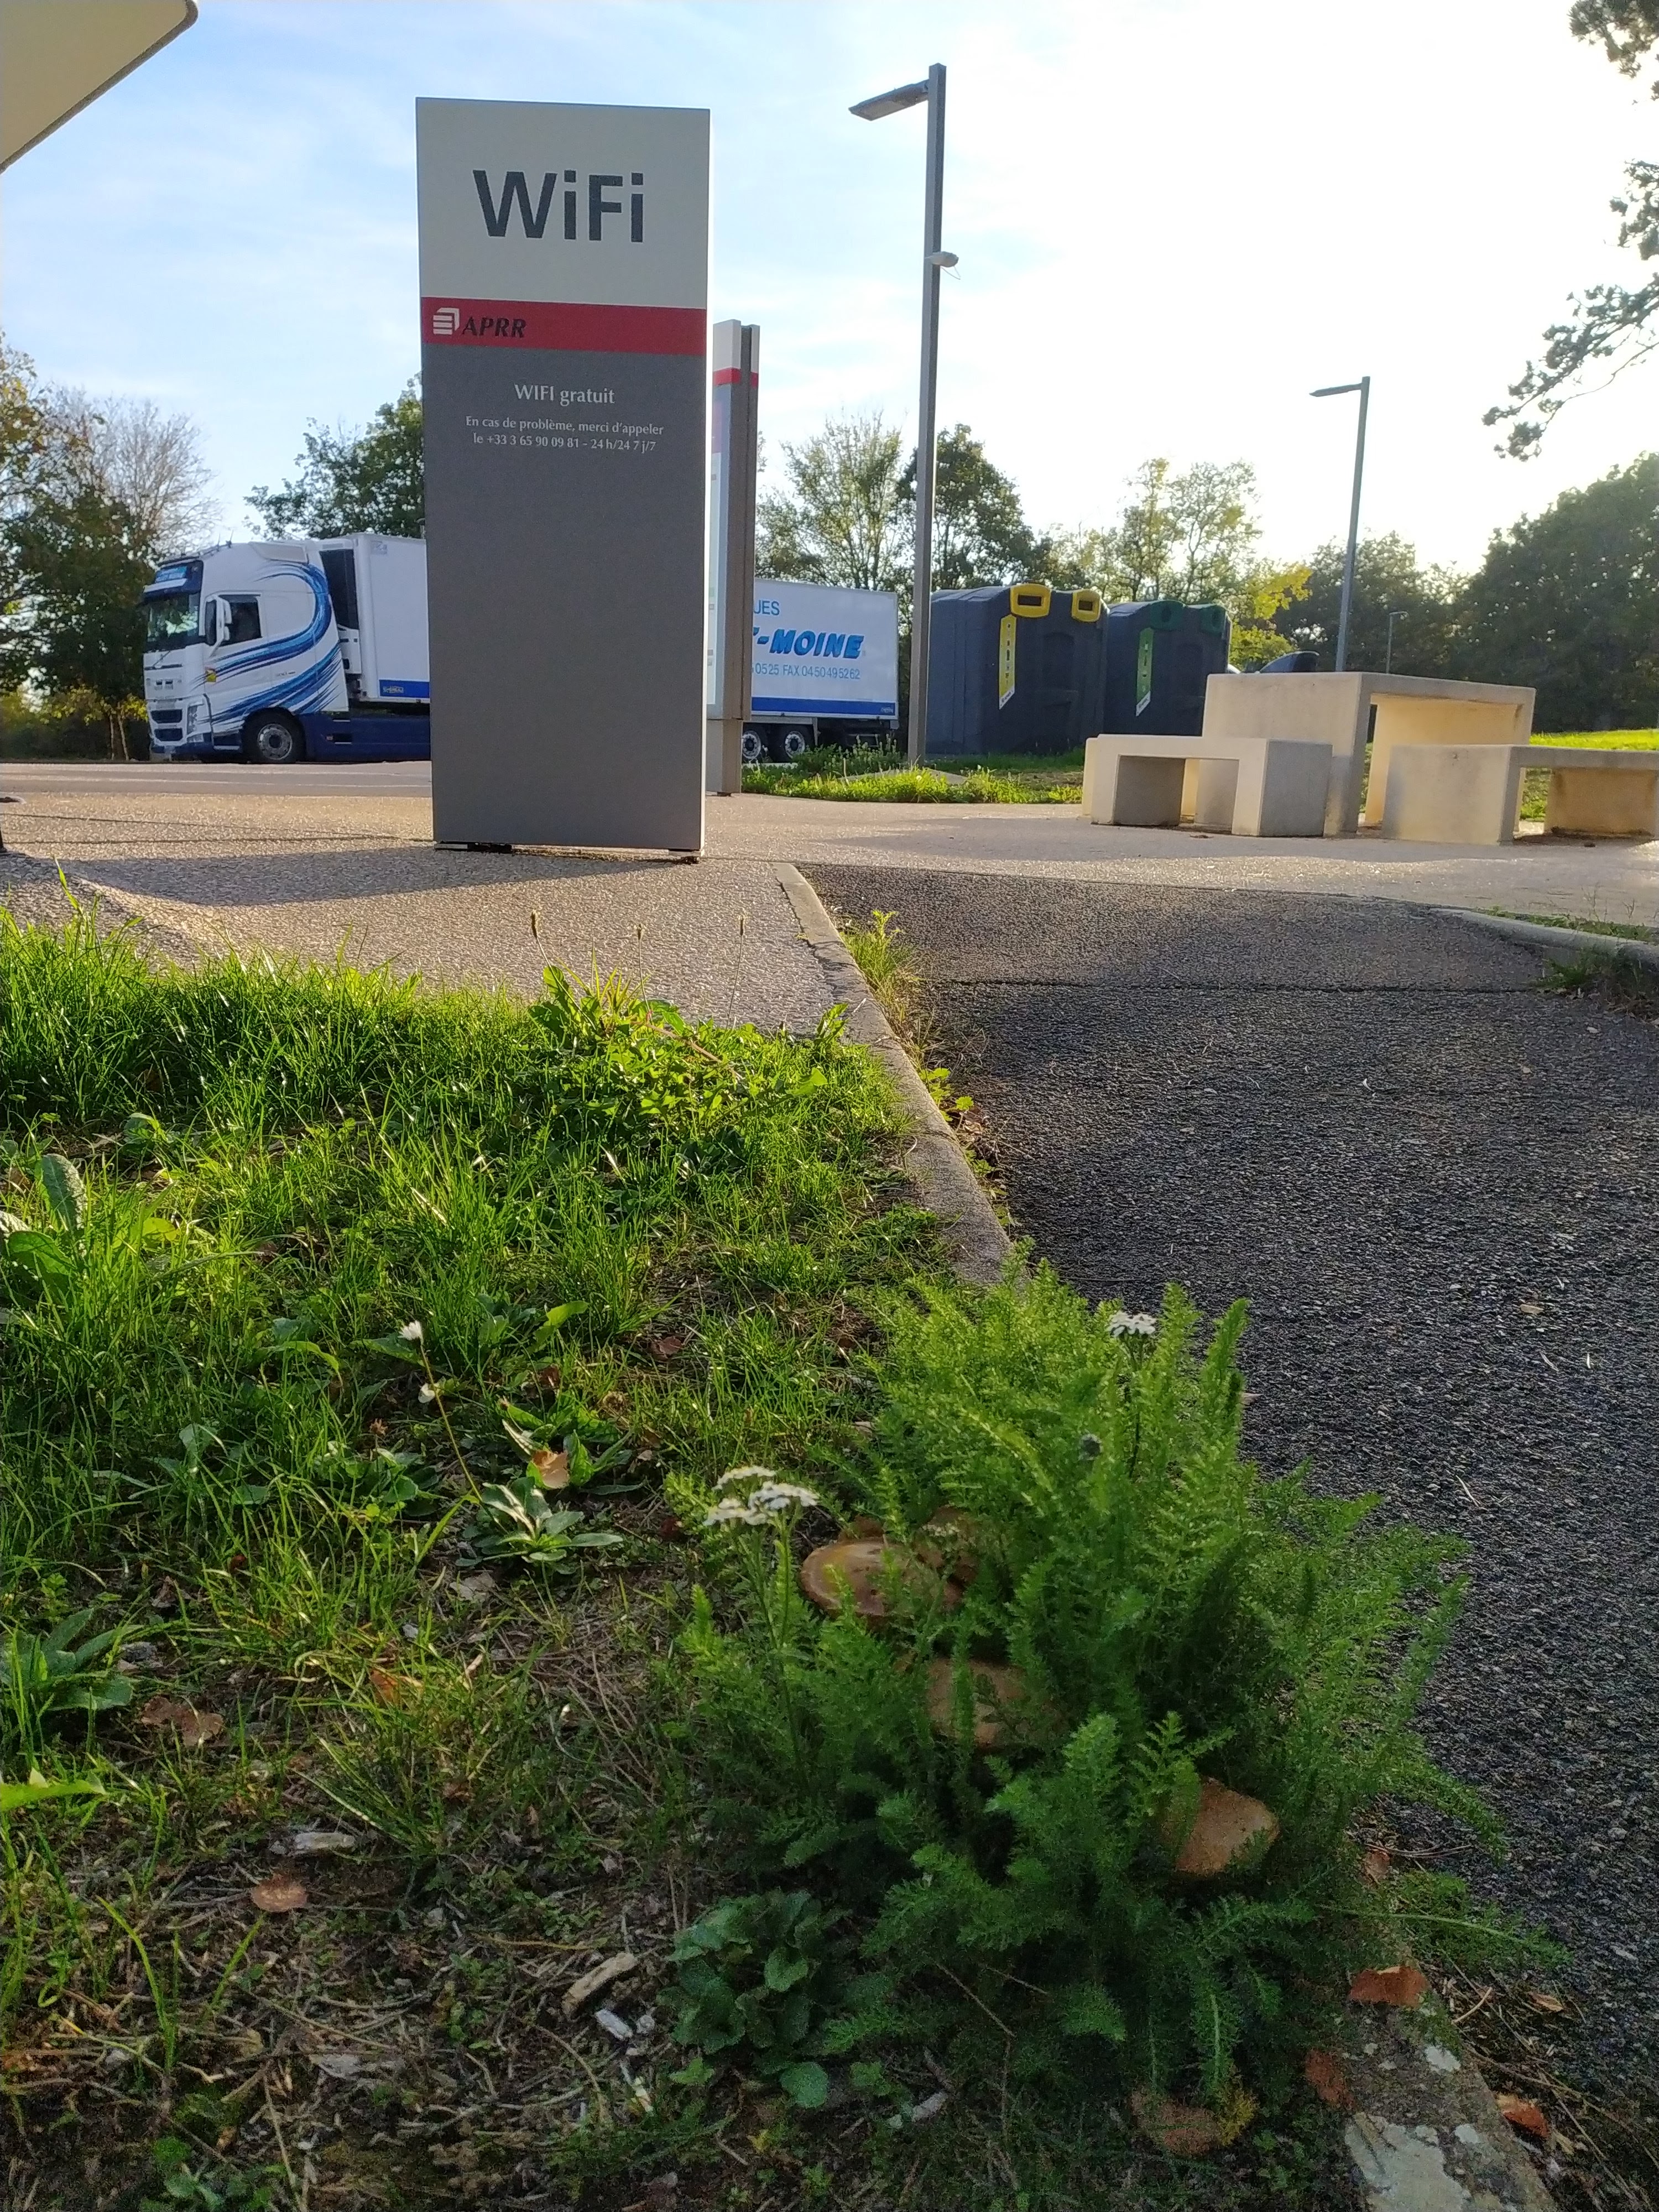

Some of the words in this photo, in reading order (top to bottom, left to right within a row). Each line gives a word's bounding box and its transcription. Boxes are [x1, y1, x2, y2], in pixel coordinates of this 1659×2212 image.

[472, 169, 644, 243] WiFi
[461, 316, 526, 338] APRR
[514, 383, 554, 401] WIFI
[560, 388, 615, 407] gratuit
[466, 415, 479, 426] En
[482, 418, 500, 427] cas
[502, 417, 516, 428] de
[519, 418, 575, 432] problème,
[578, 422, 609, 433] merci
[612, 422, 664, 436] d'appeler
[473, 432, 483, 444] le
[487, 434, 507, 445] +33
[510, 435, 517, 445] 3
[519, 435, 533, 446] 65
[535, 436, 548, 447] 90
[551, 437, 564, 447] 09
[567, 437, 579, 448] 81
[753, 627, 864, 659] -MOINE
[752, 662, 779, 675] 0525
[783, 664, 800, 676] FAX
